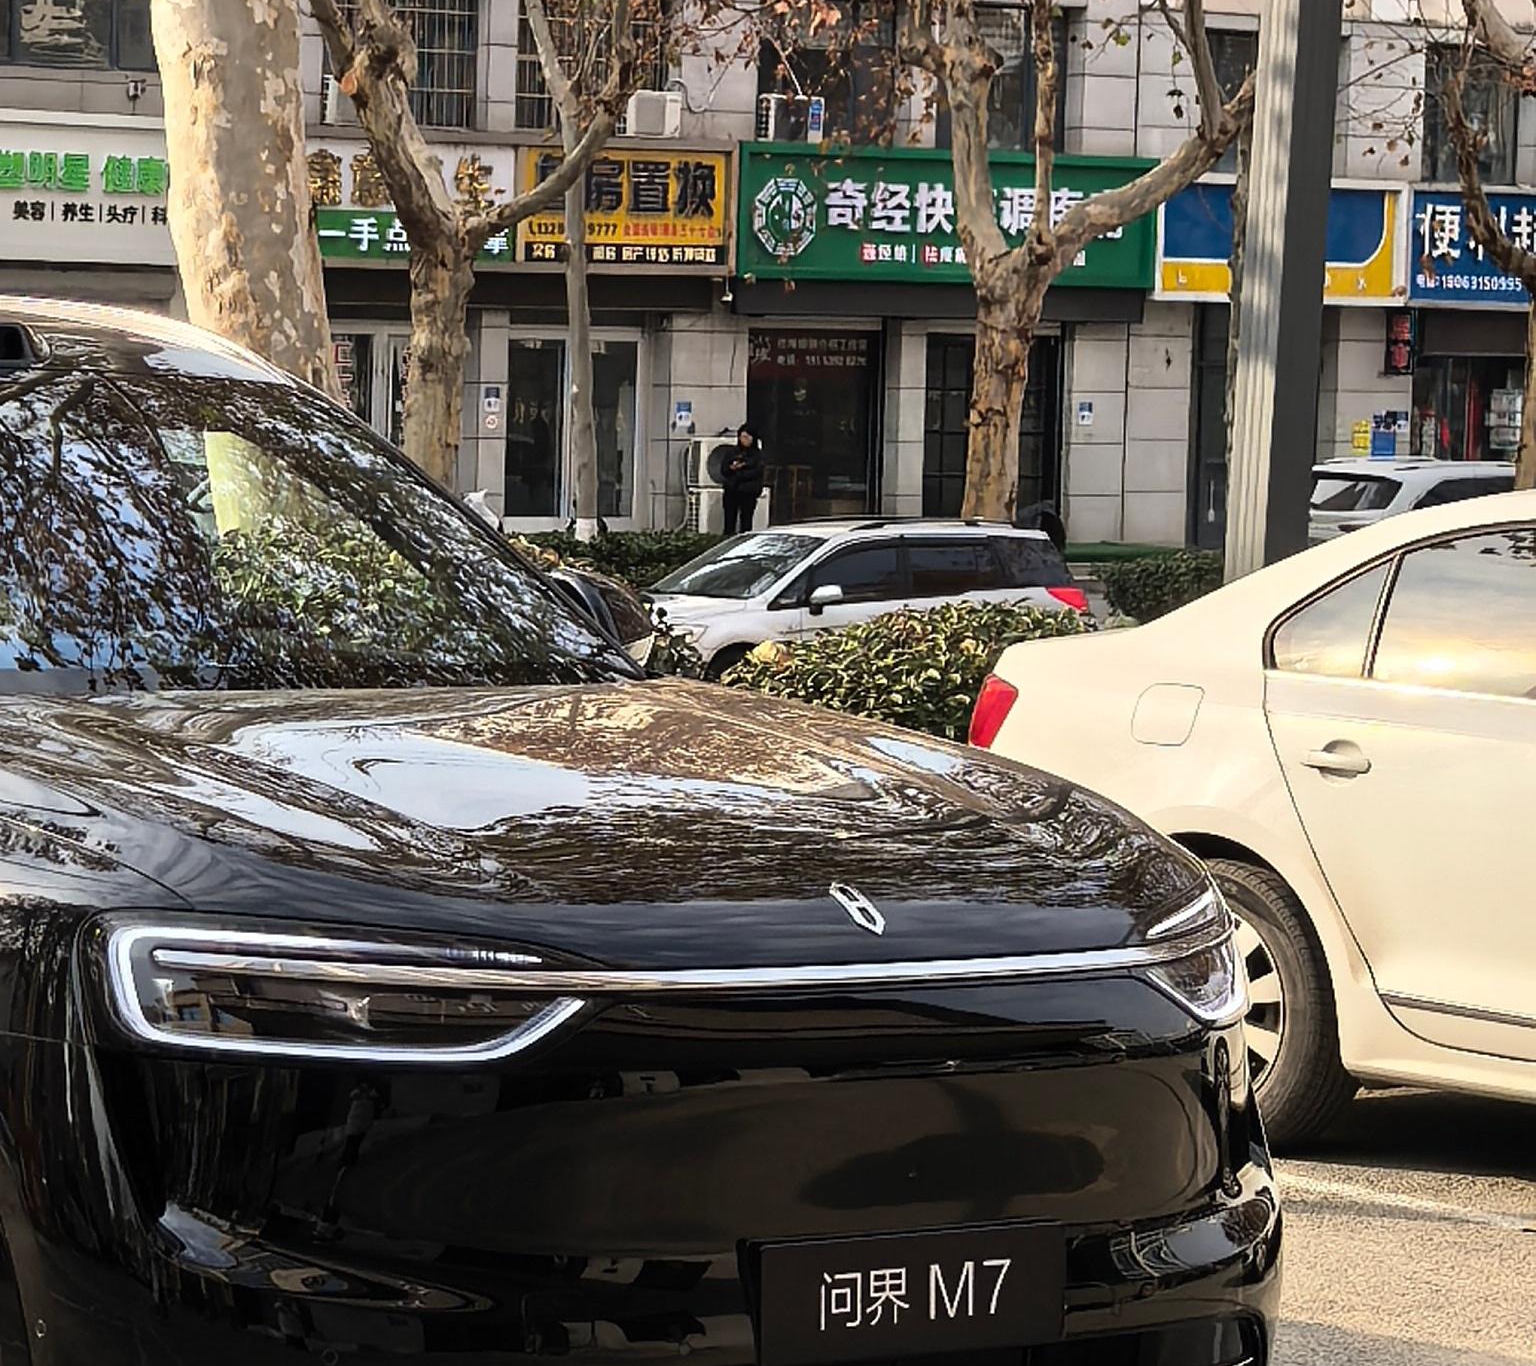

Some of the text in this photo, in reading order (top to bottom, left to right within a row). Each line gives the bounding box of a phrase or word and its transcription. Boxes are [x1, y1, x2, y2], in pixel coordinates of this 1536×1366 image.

[101, 155, 169, 196] 健康
[13, 200, 46, 221] 美容
[62, 202, 95, 223] 养生
[819, 1258, 1012, 1331] 问界 M7
